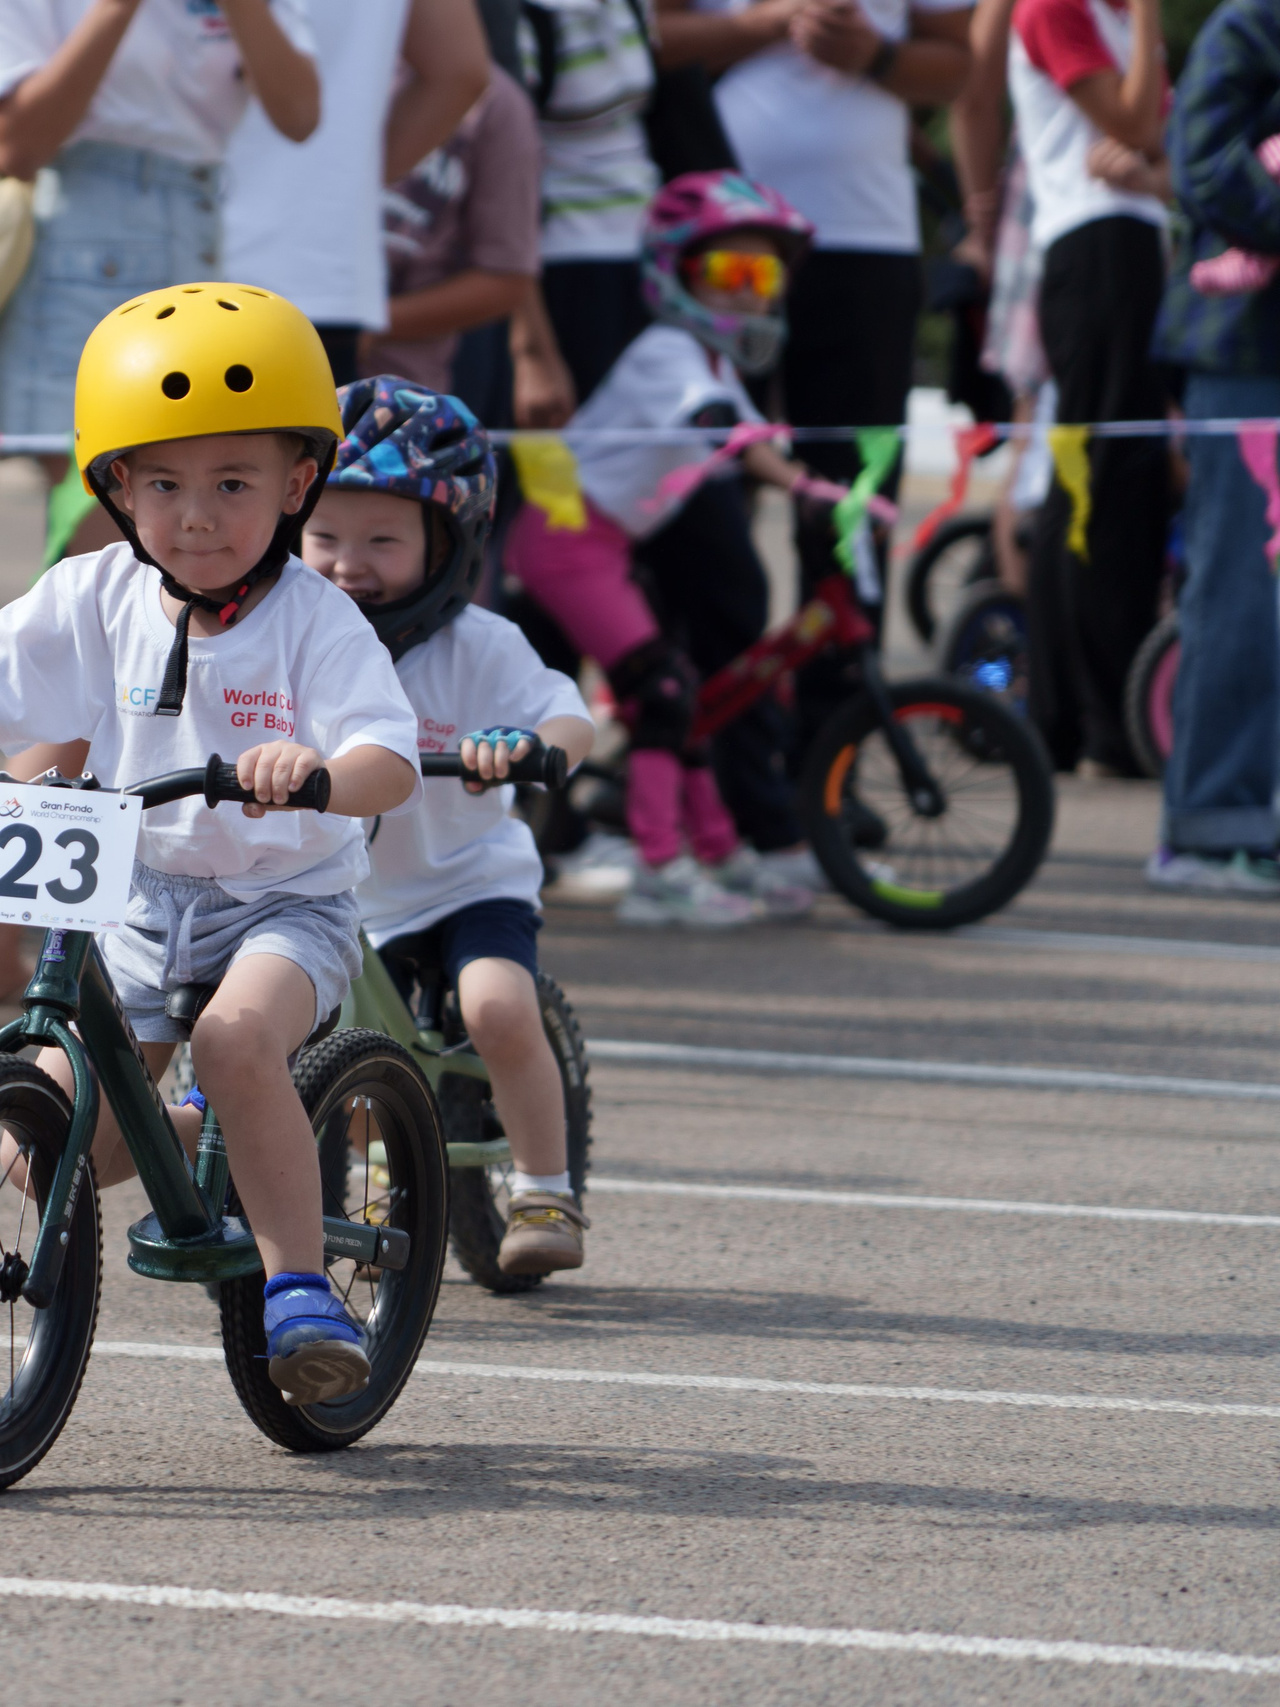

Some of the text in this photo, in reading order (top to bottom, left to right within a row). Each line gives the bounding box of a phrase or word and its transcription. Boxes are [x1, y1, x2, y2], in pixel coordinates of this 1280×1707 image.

[122, 686, 156, 706] ACF
[223, 688, 294, 711] World Cu
[231, 711, 295, 737] GF Baby
[423, 718, 456, 737] Cup
[417, 736, 447, 754] aby
[31, 810, 49, 818] World
[40, 801, 93, 813] Gran Fondo
[327, 1234, 363, 1248] FLYING PIGEON
